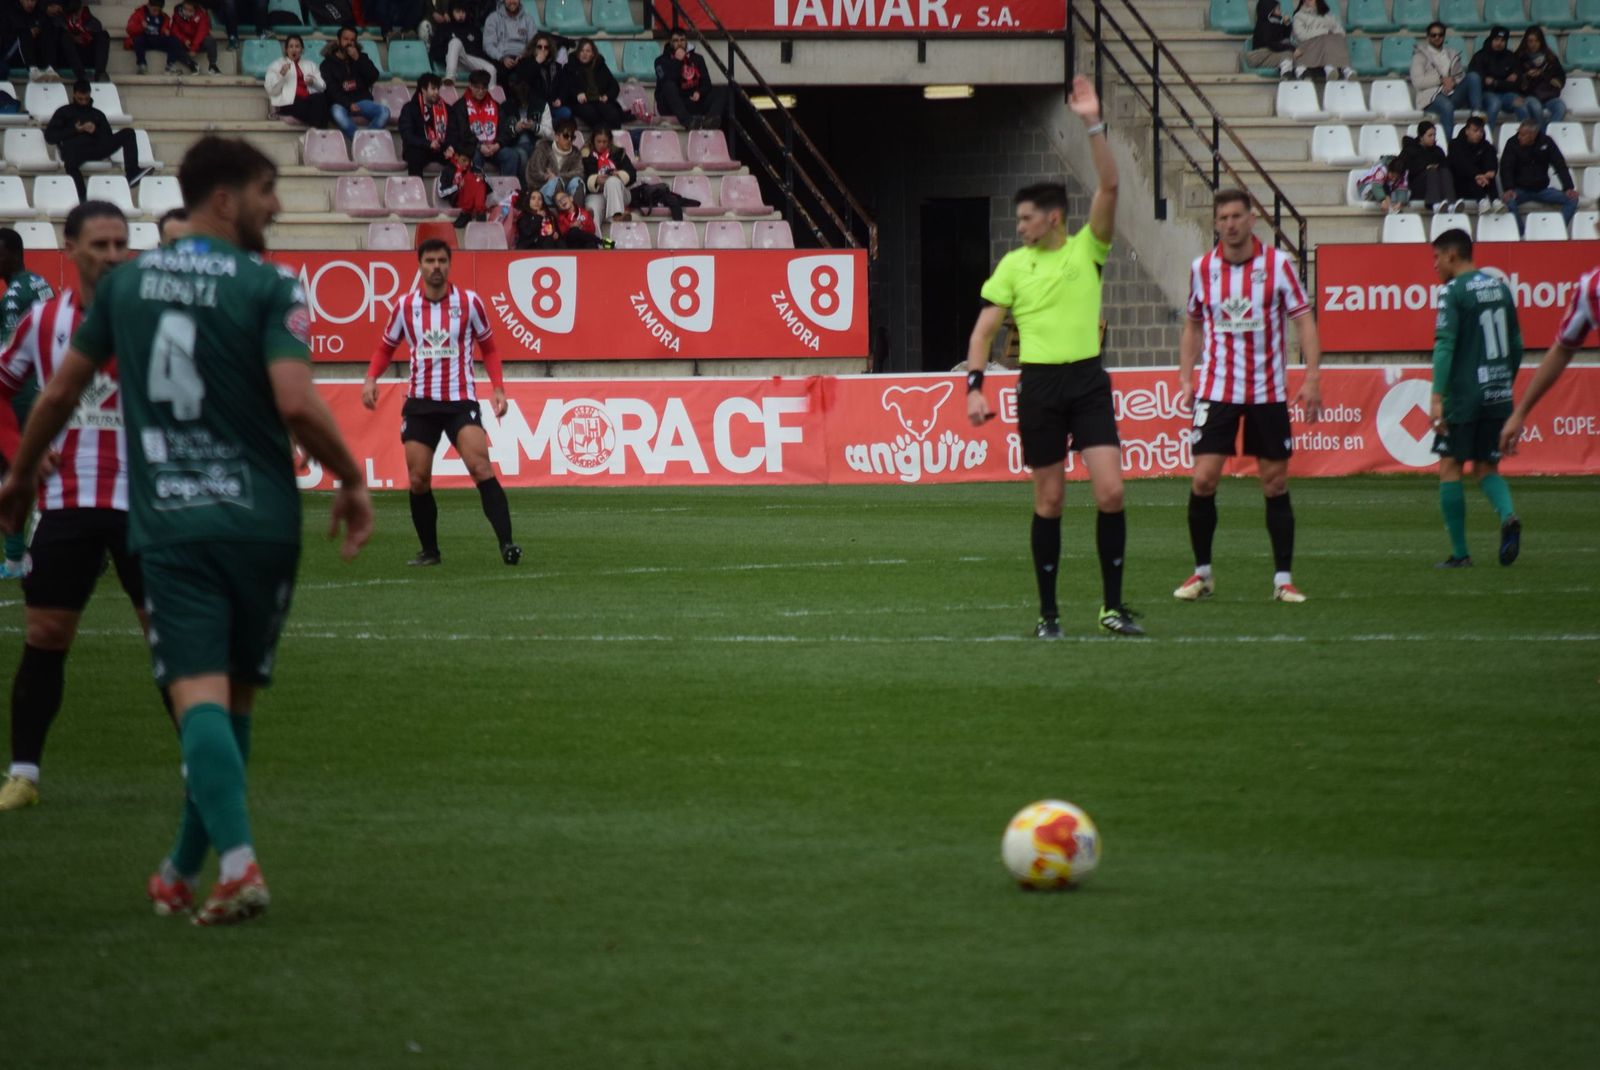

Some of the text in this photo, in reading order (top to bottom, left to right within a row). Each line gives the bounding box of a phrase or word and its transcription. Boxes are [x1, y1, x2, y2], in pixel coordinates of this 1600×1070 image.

[976, 6, 1020, 27] S.A.
[532, 266, 562, 318] 8
[670, 265, 700, 317] 8
[810, 264, 840, 316] 8
[1324, 283, 1446, 311] zamor
[1511, 272, 1584, 309] hor
[491, 291, 542, 354] ZAMORA
[630, 290, 681, 352] ZAMORA
[771, 289, 820, 351] ZAMORA
[1479, 307, 1509, 360] 11
[147, 311, 205, 421] 4
[712, 396, 809, 475] CF
[845, 430, 988, 483] angura
[1343, 433, 1365, 450] en
